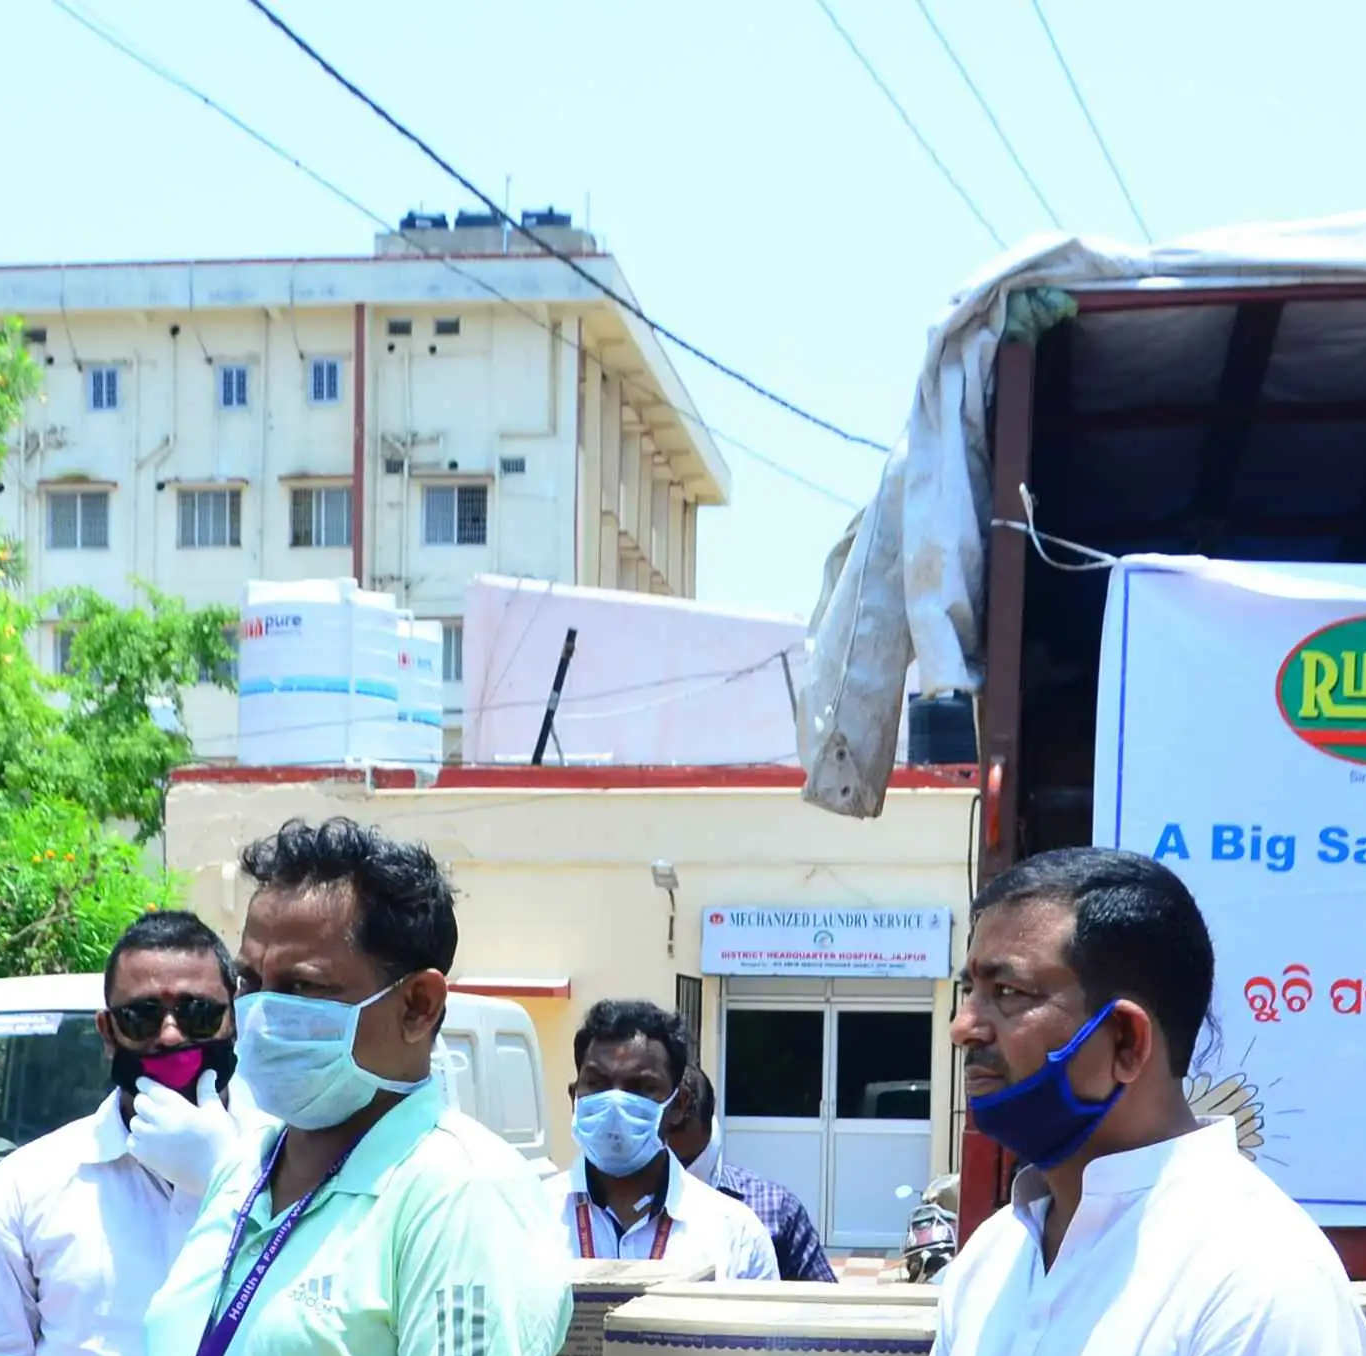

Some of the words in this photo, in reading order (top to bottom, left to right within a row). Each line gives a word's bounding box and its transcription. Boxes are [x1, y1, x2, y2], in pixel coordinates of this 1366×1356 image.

[1153, 823, 1190, 860] A
[1211, 824, 1296, 872] Big
[730, 911, 810, 928] MECHANIZED
[813, 912, 867, 929] LAUNDRY
[872, 913, 923, 929] SERVICE
[721, 951, 763, 960] DISTRICT
[766, 951, 836, 961] HEADQUARTER
[1244, 963, 1313, 1022] ରୁଚି
[228, 1277, 258, 1321] Health
[255, 1264, 267, 1276] &
[263, 1220, 292, 1262] Family
